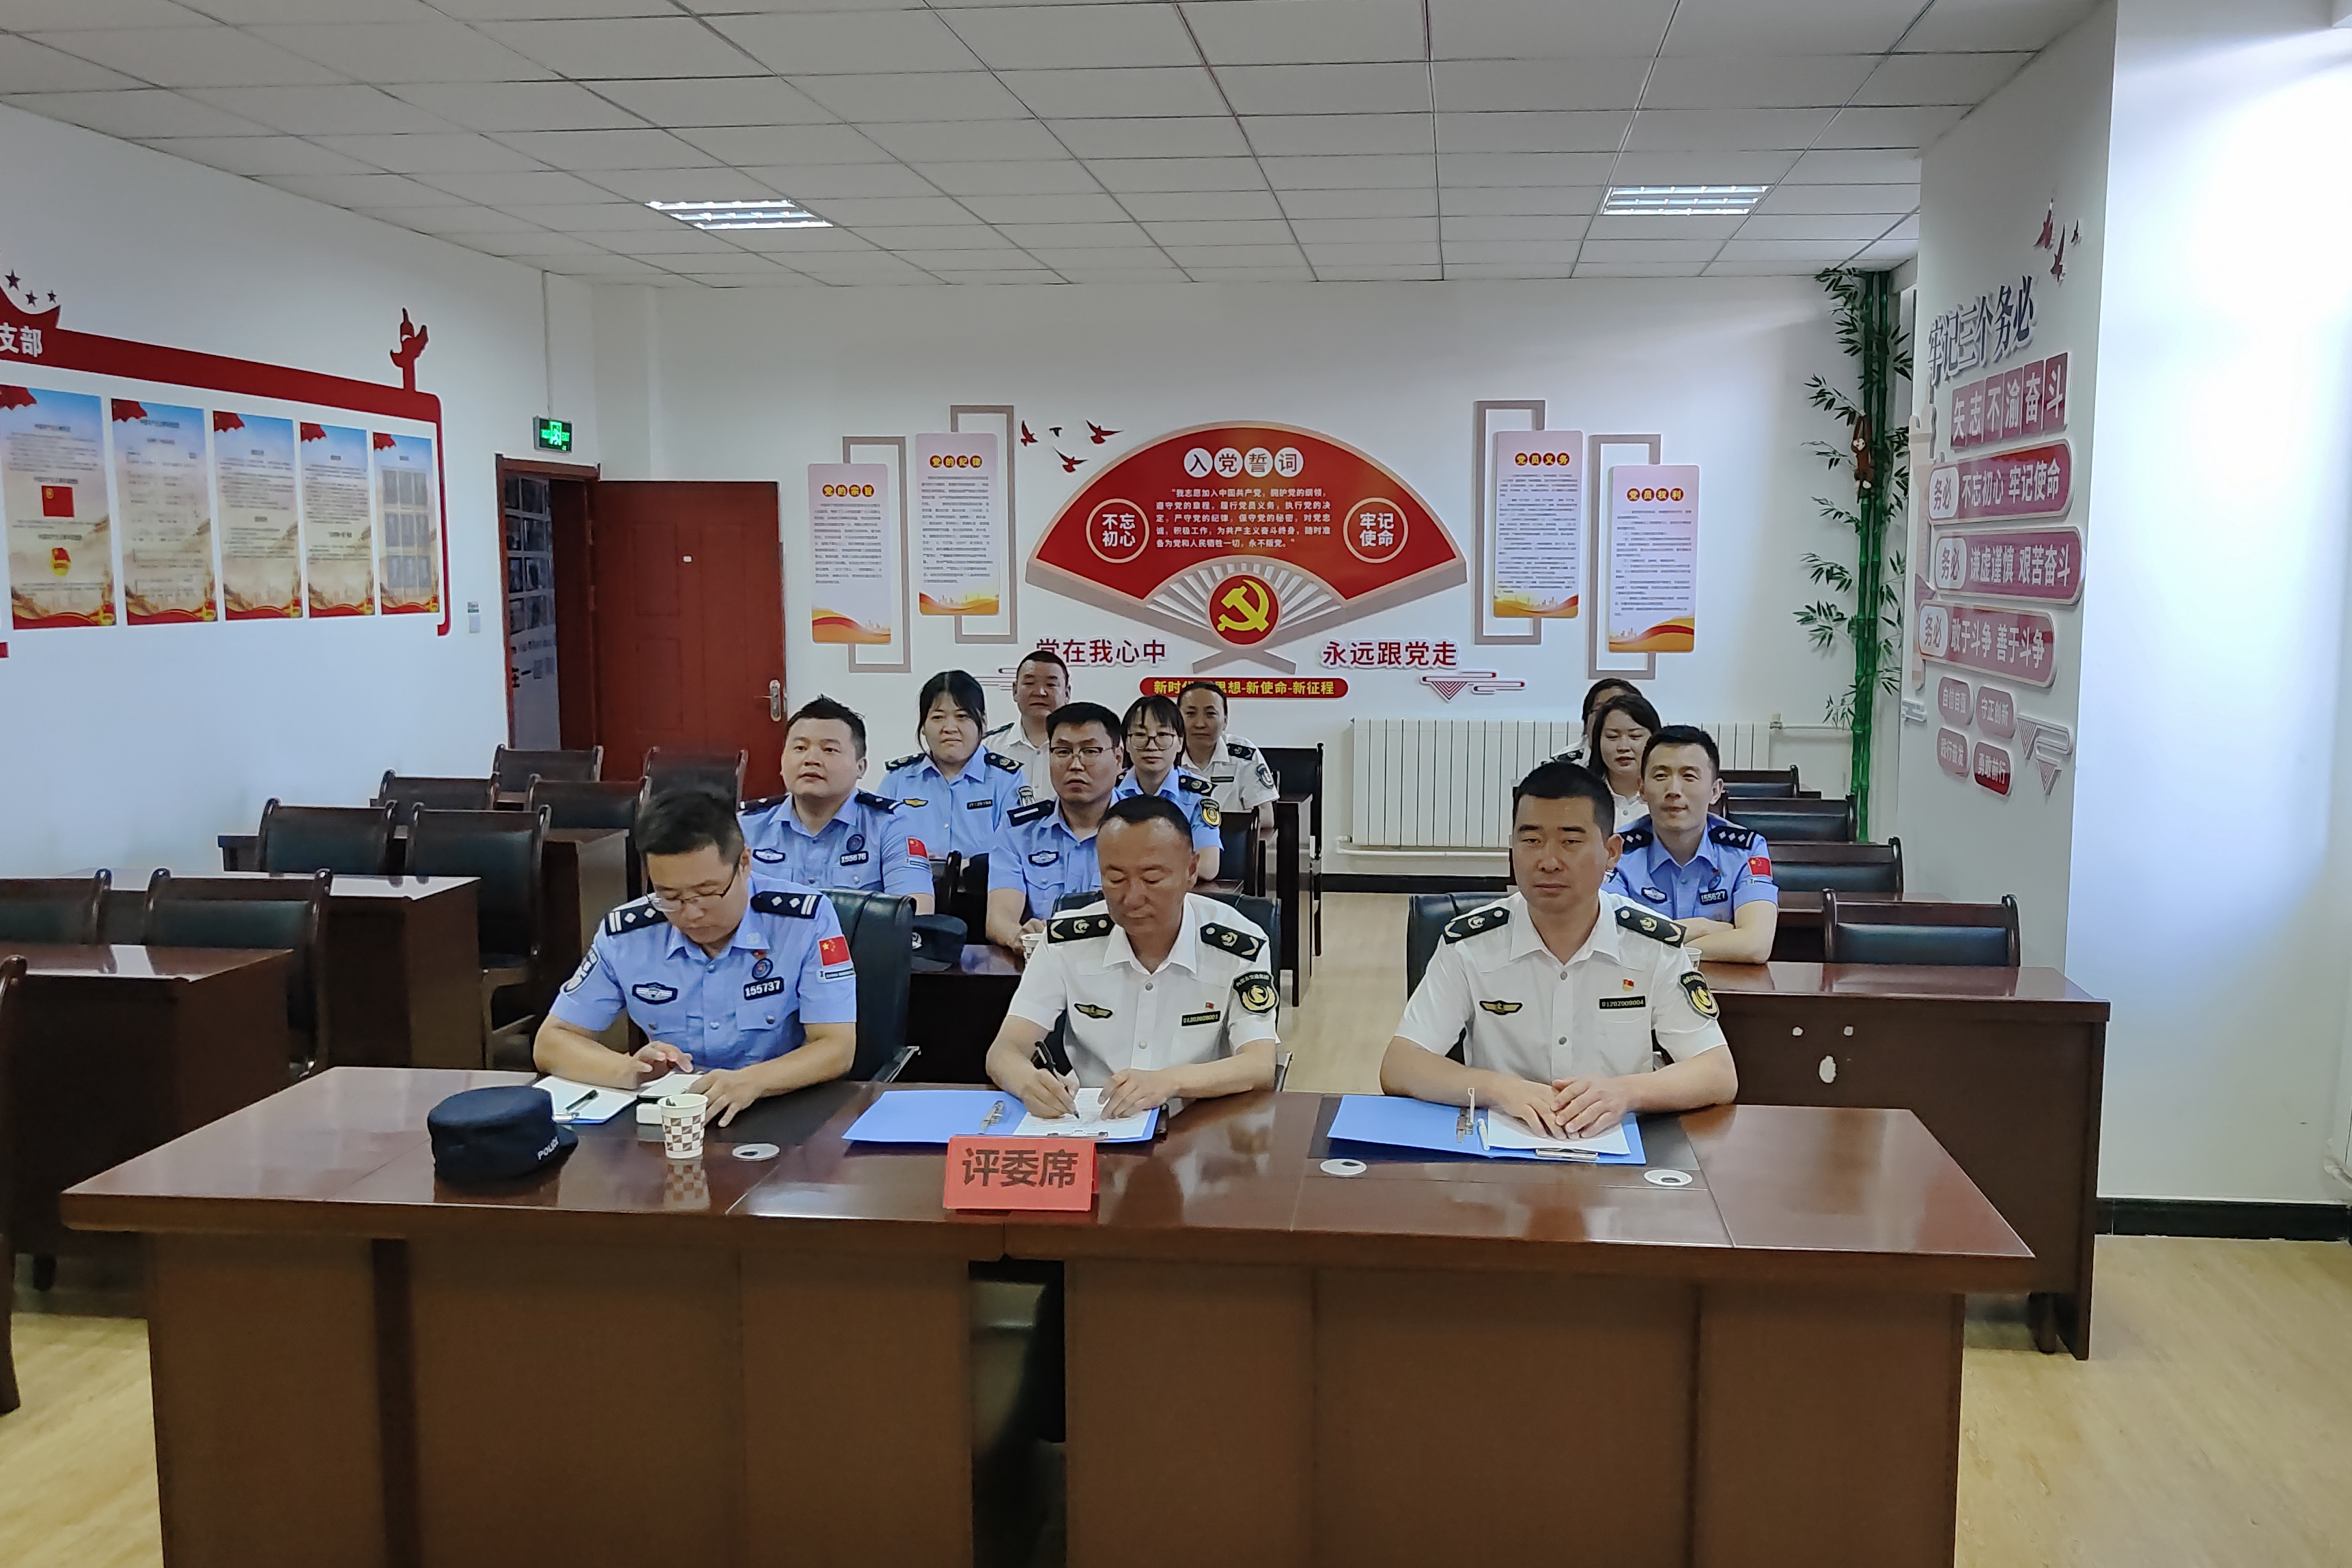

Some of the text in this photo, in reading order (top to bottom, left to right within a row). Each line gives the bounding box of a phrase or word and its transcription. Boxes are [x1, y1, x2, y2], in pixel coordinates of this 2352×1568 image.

[1952, 363, 2063, 442] 矢志不渝奋斗
[1188, 453, 1298, 474] 入党誓词
[1933, 457, 2061, 511] 务必 不忘初心 牢记使命
[1102, 512, 1136, 530] 不忘
[1360, 512, 1395, 530] 牢记
[1102, 530, 1136, 548] 初心
[1359, 530, 1395, 548] 使命
[1941, 547, 1960, 580] 务必
[2018, 544, 2071, 587] 艰苦奋斗
[1323, 641, 1457, 666] 永远跟党走
[1924, 615, 2045, 669] 务必 敢于斗争 善于斗争
[1980, 697, 2009, 727] 守正创新
[744, 980, 781, 997] 155737
[962, 1147, 1079, 1188] 评委席
